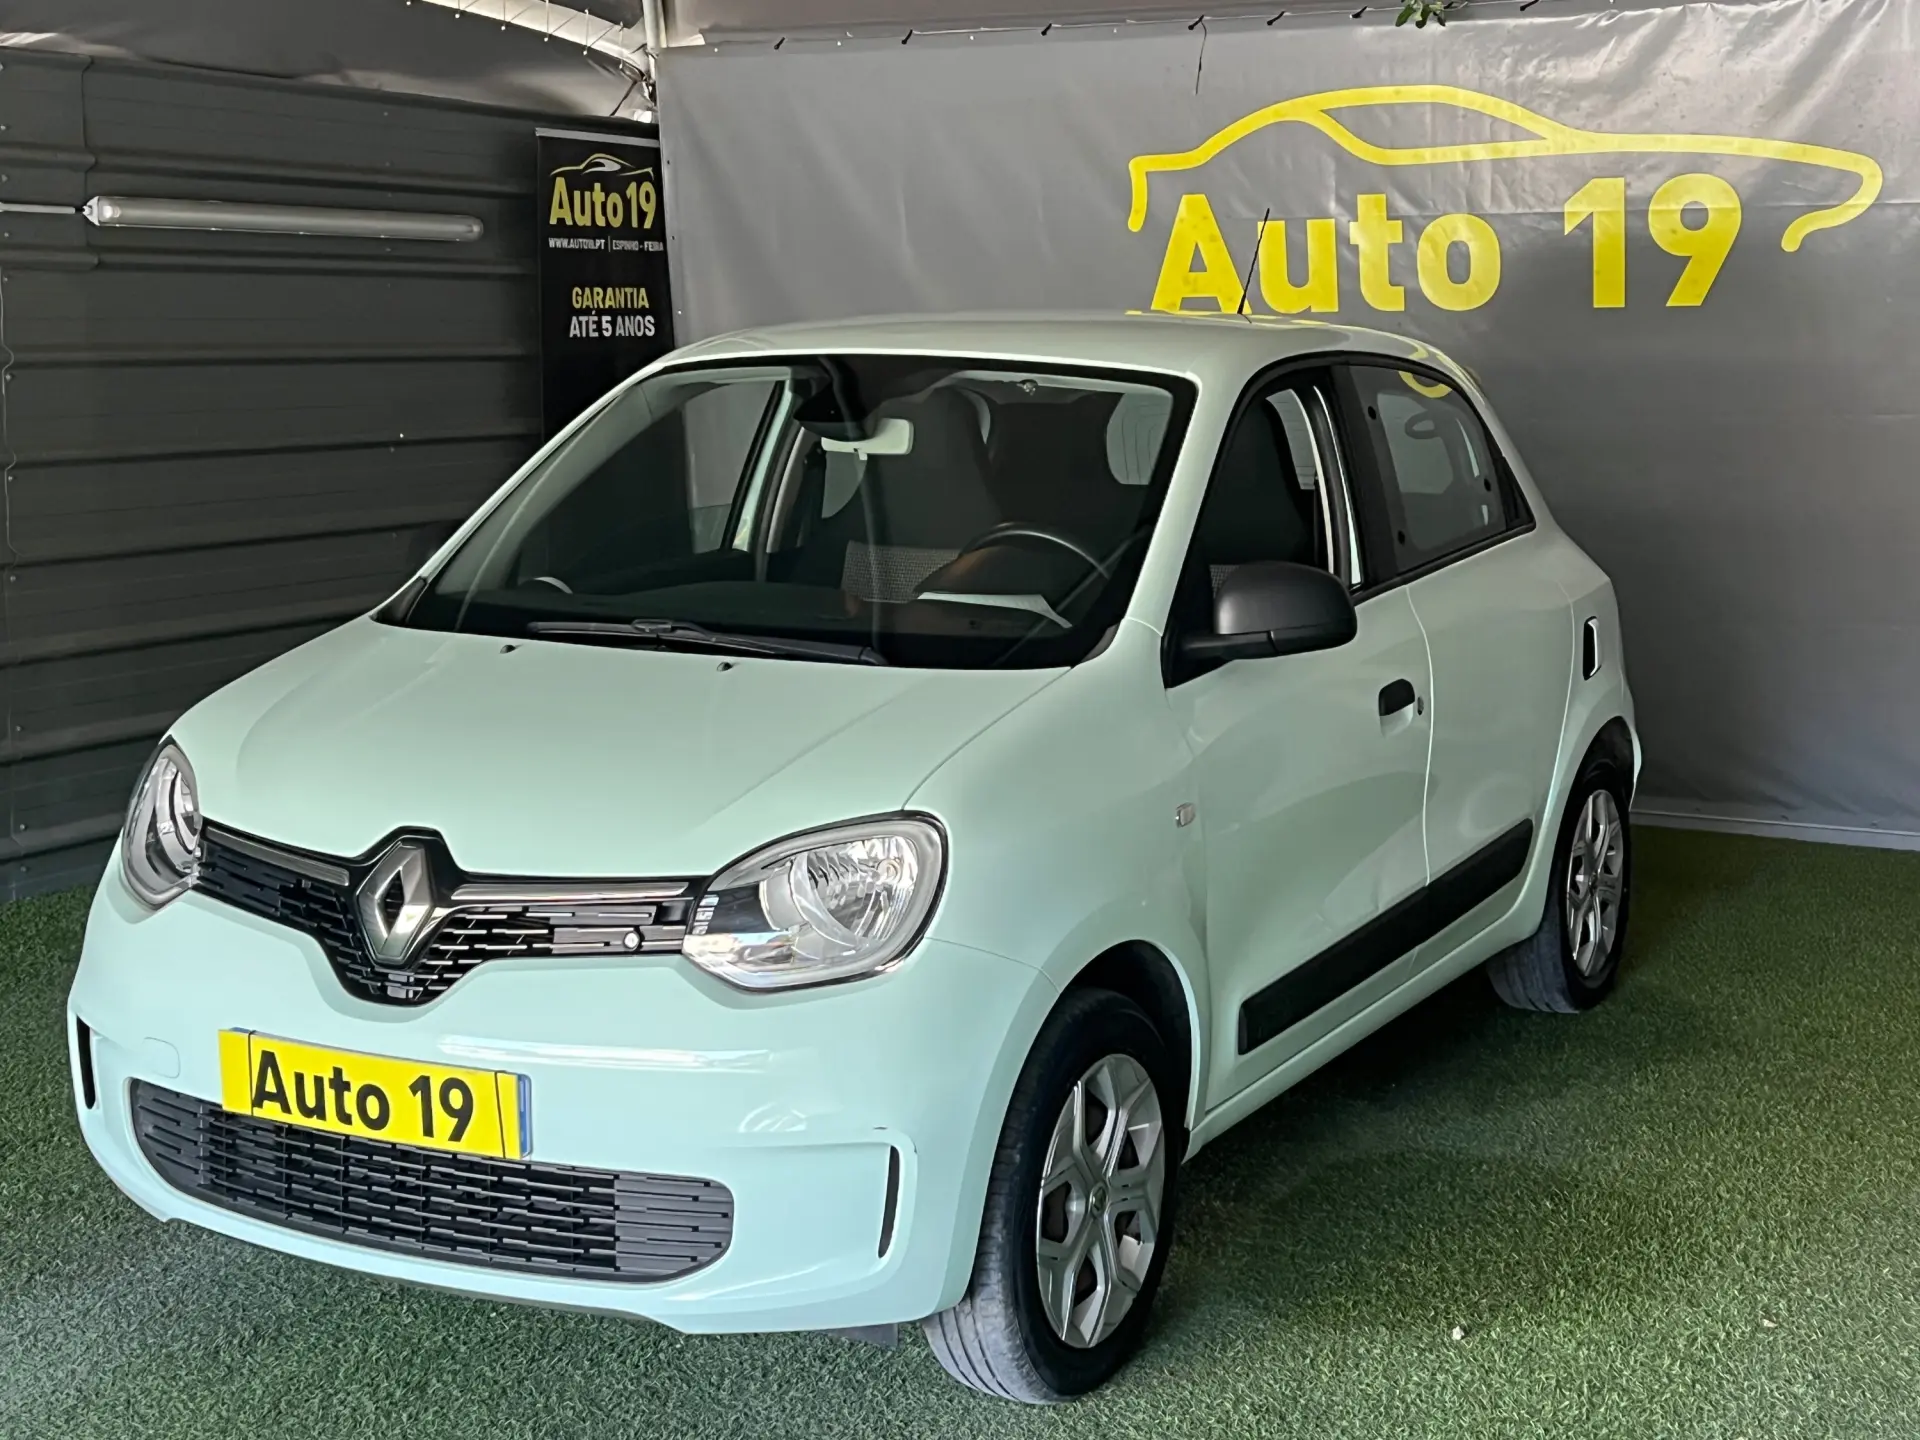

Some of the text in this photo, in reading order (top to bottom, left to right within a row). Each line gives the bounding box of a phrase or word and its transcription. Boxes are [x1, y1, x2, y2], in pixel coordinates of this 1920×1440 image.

[549, 177, 656, 229] Auto 19
[1150, 173, 1742, 315] Auto 19
[572, 287, 649, 309] GARANTIA
[569, 311, 655, 338] ATÉ 5 ANOS
[251, 1049, 474, 1143] Auto 19
